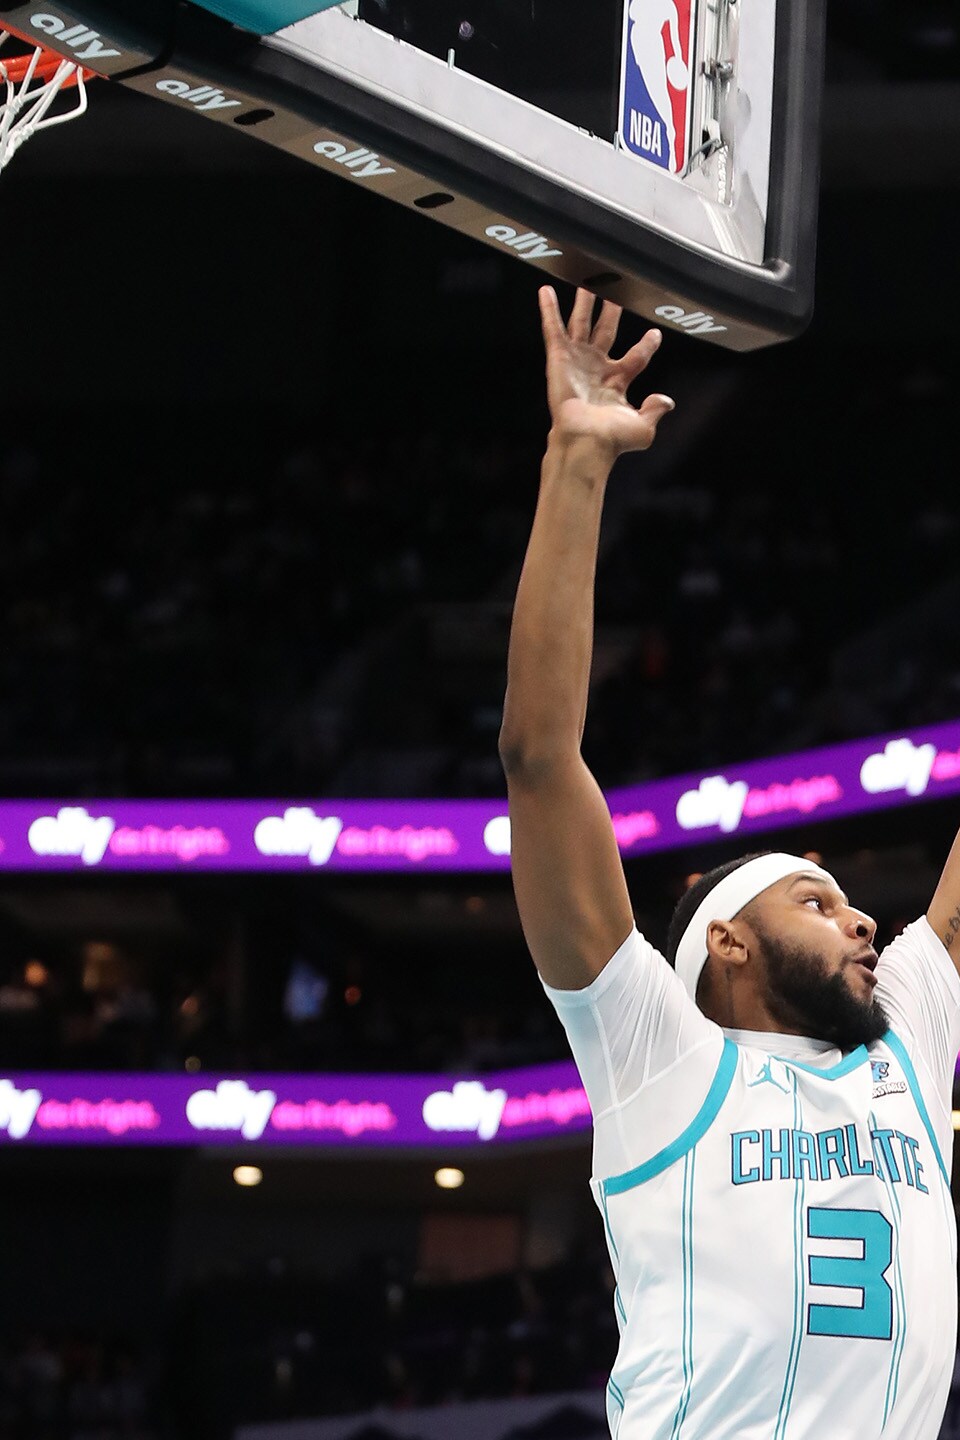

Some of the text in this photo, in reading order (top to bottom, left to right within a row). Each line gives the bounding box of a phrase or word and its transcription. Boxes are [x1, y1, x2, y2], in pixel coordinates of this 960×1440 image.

[29, 12, 122, 59] ally
[155, 77, 242, 112] ally
[628, 108, 663, 158] NBA
[312, 138, 395, 179] ally
[484, 223, 562, 260] ally
[653, 303, 728, 335] ally
[730, 1123, 929, 1194] CHARLTTE
[807, 1207, 892, 1340] 3
